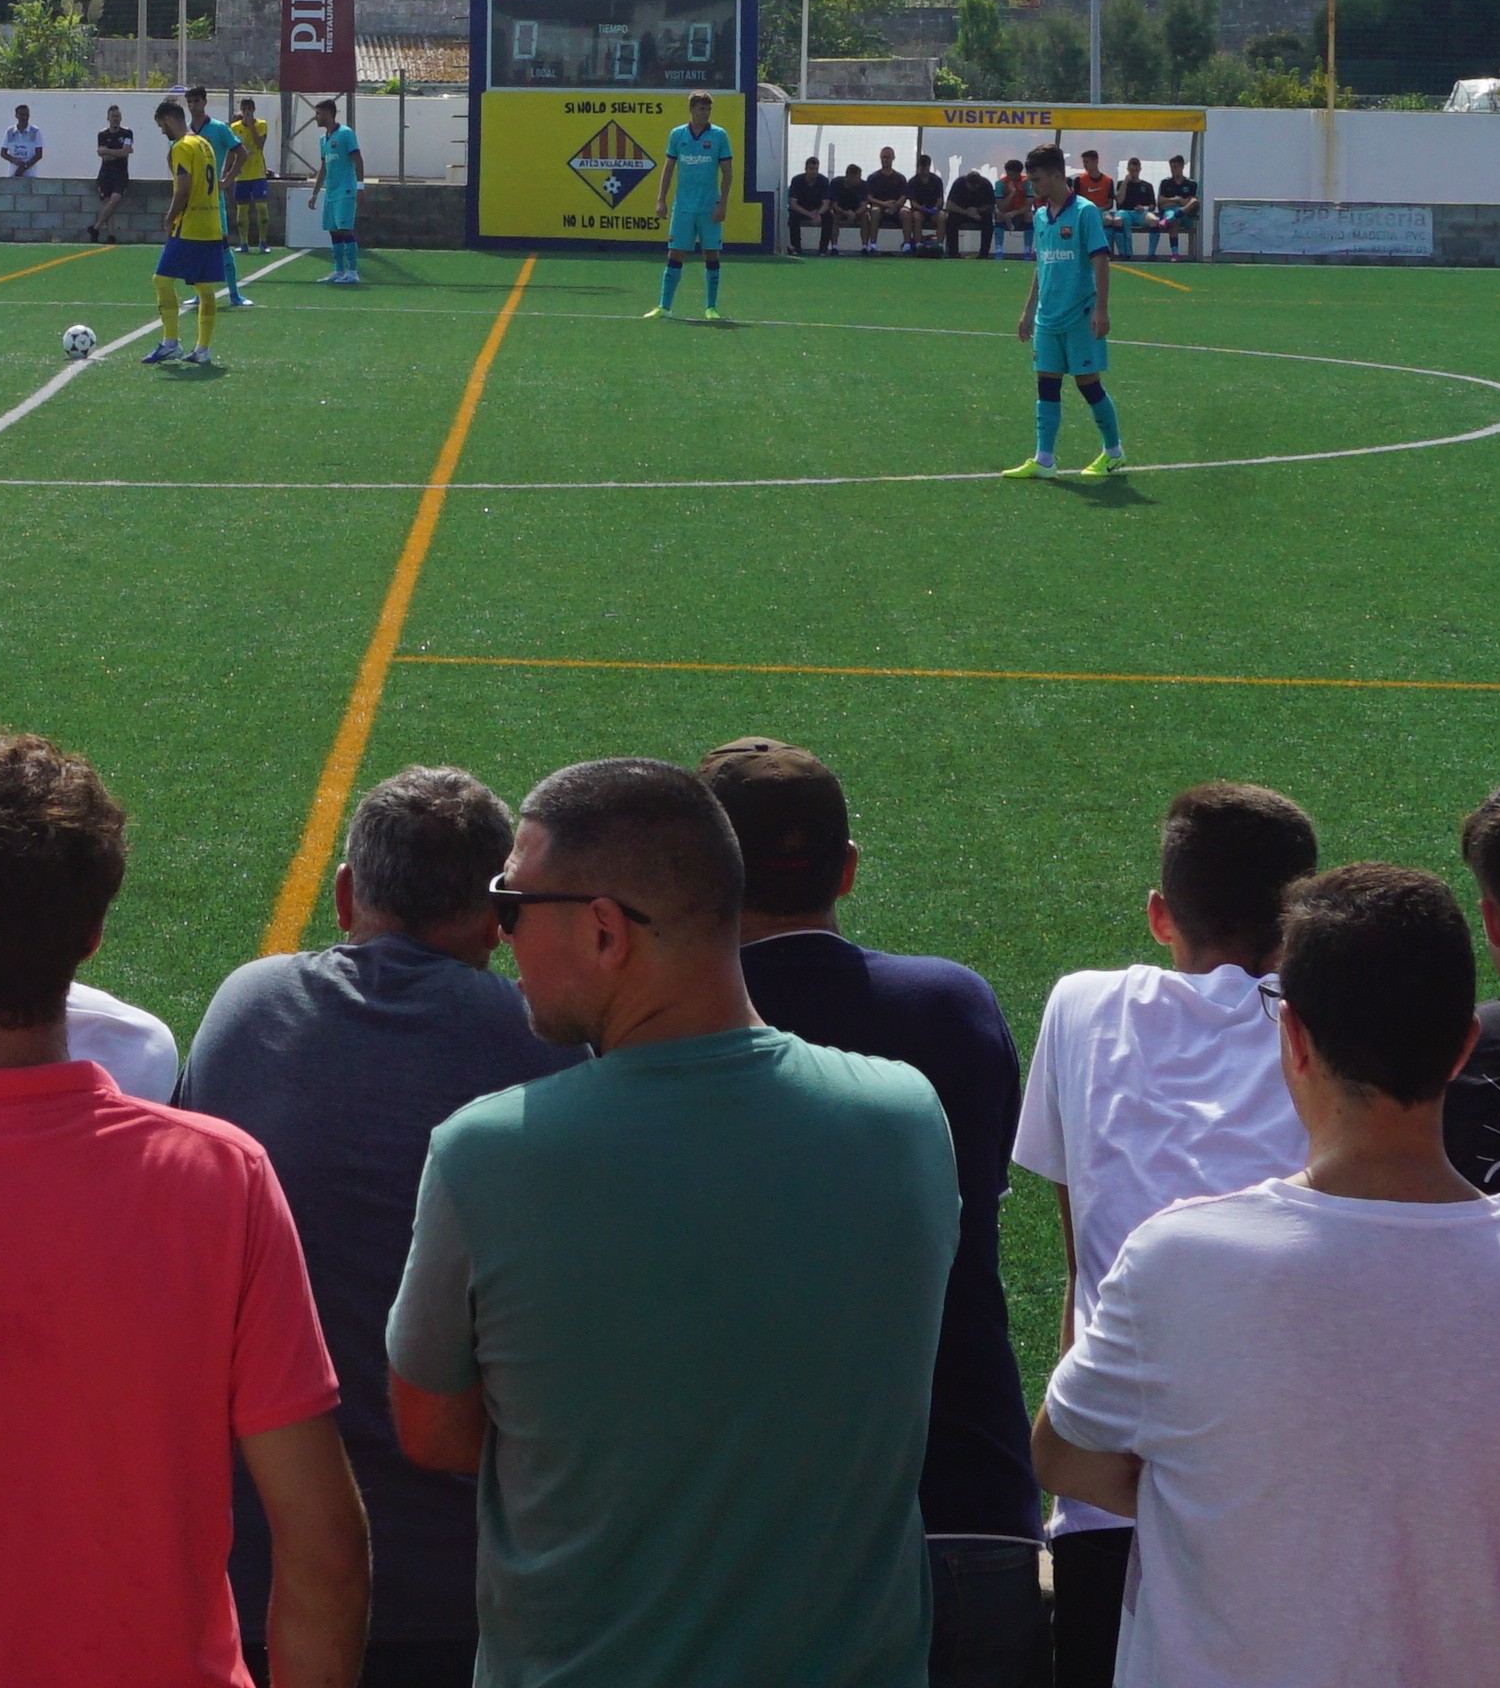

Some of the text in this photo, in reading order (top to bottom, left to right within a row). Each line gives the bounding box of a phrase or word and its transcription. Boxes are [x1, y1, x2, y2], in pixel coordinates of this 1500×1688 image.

[598, 24, 629, 34] TIEMPO
[664, 70, 707, 81] VISITANTE
[564, 102, 575, 113] SI
[610, 102, 663, 114] SIENTES
[944, 109, 1052, 125] VISITANTE
[205, 163, 215, 197] 9
[563, 214, 661, 230] NO LO ENTIENDES
